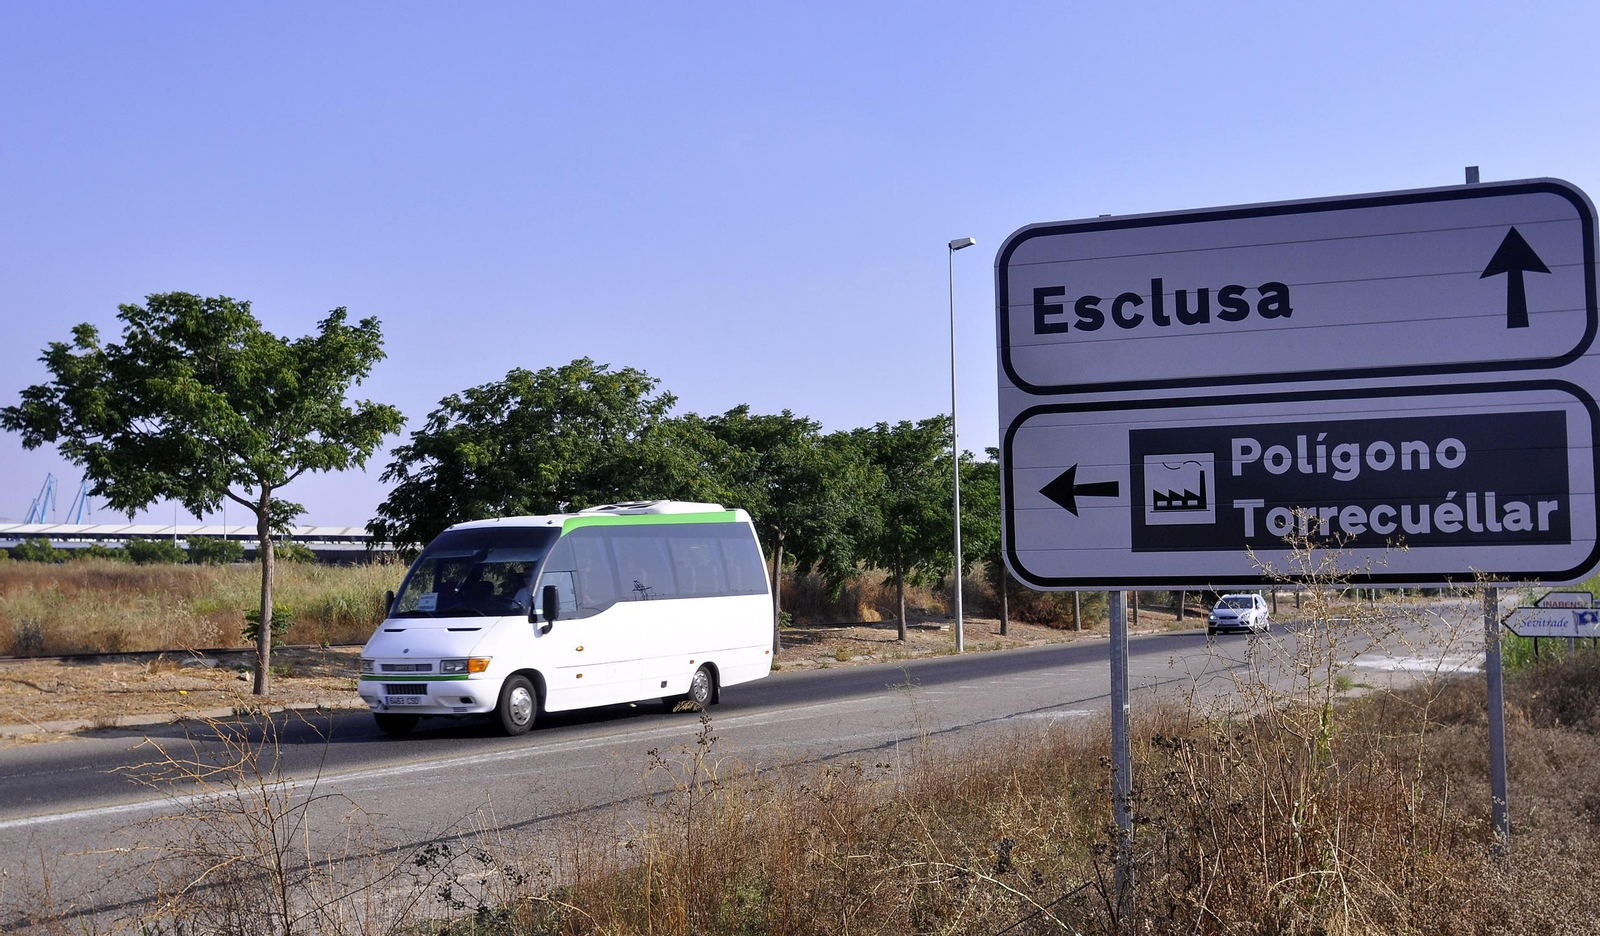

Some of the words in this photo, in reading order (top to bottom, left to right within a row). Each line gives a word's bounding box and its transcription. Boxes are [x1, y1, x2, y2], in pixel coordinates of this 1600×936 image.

[1033, 278, 1294, 335] Esclusa
[1231, 432, 1467, 481] Polígono
[1233, 491, 1558, 538] Torrecuéllar
[1520, 616, 1569, 628] Sevitrade
